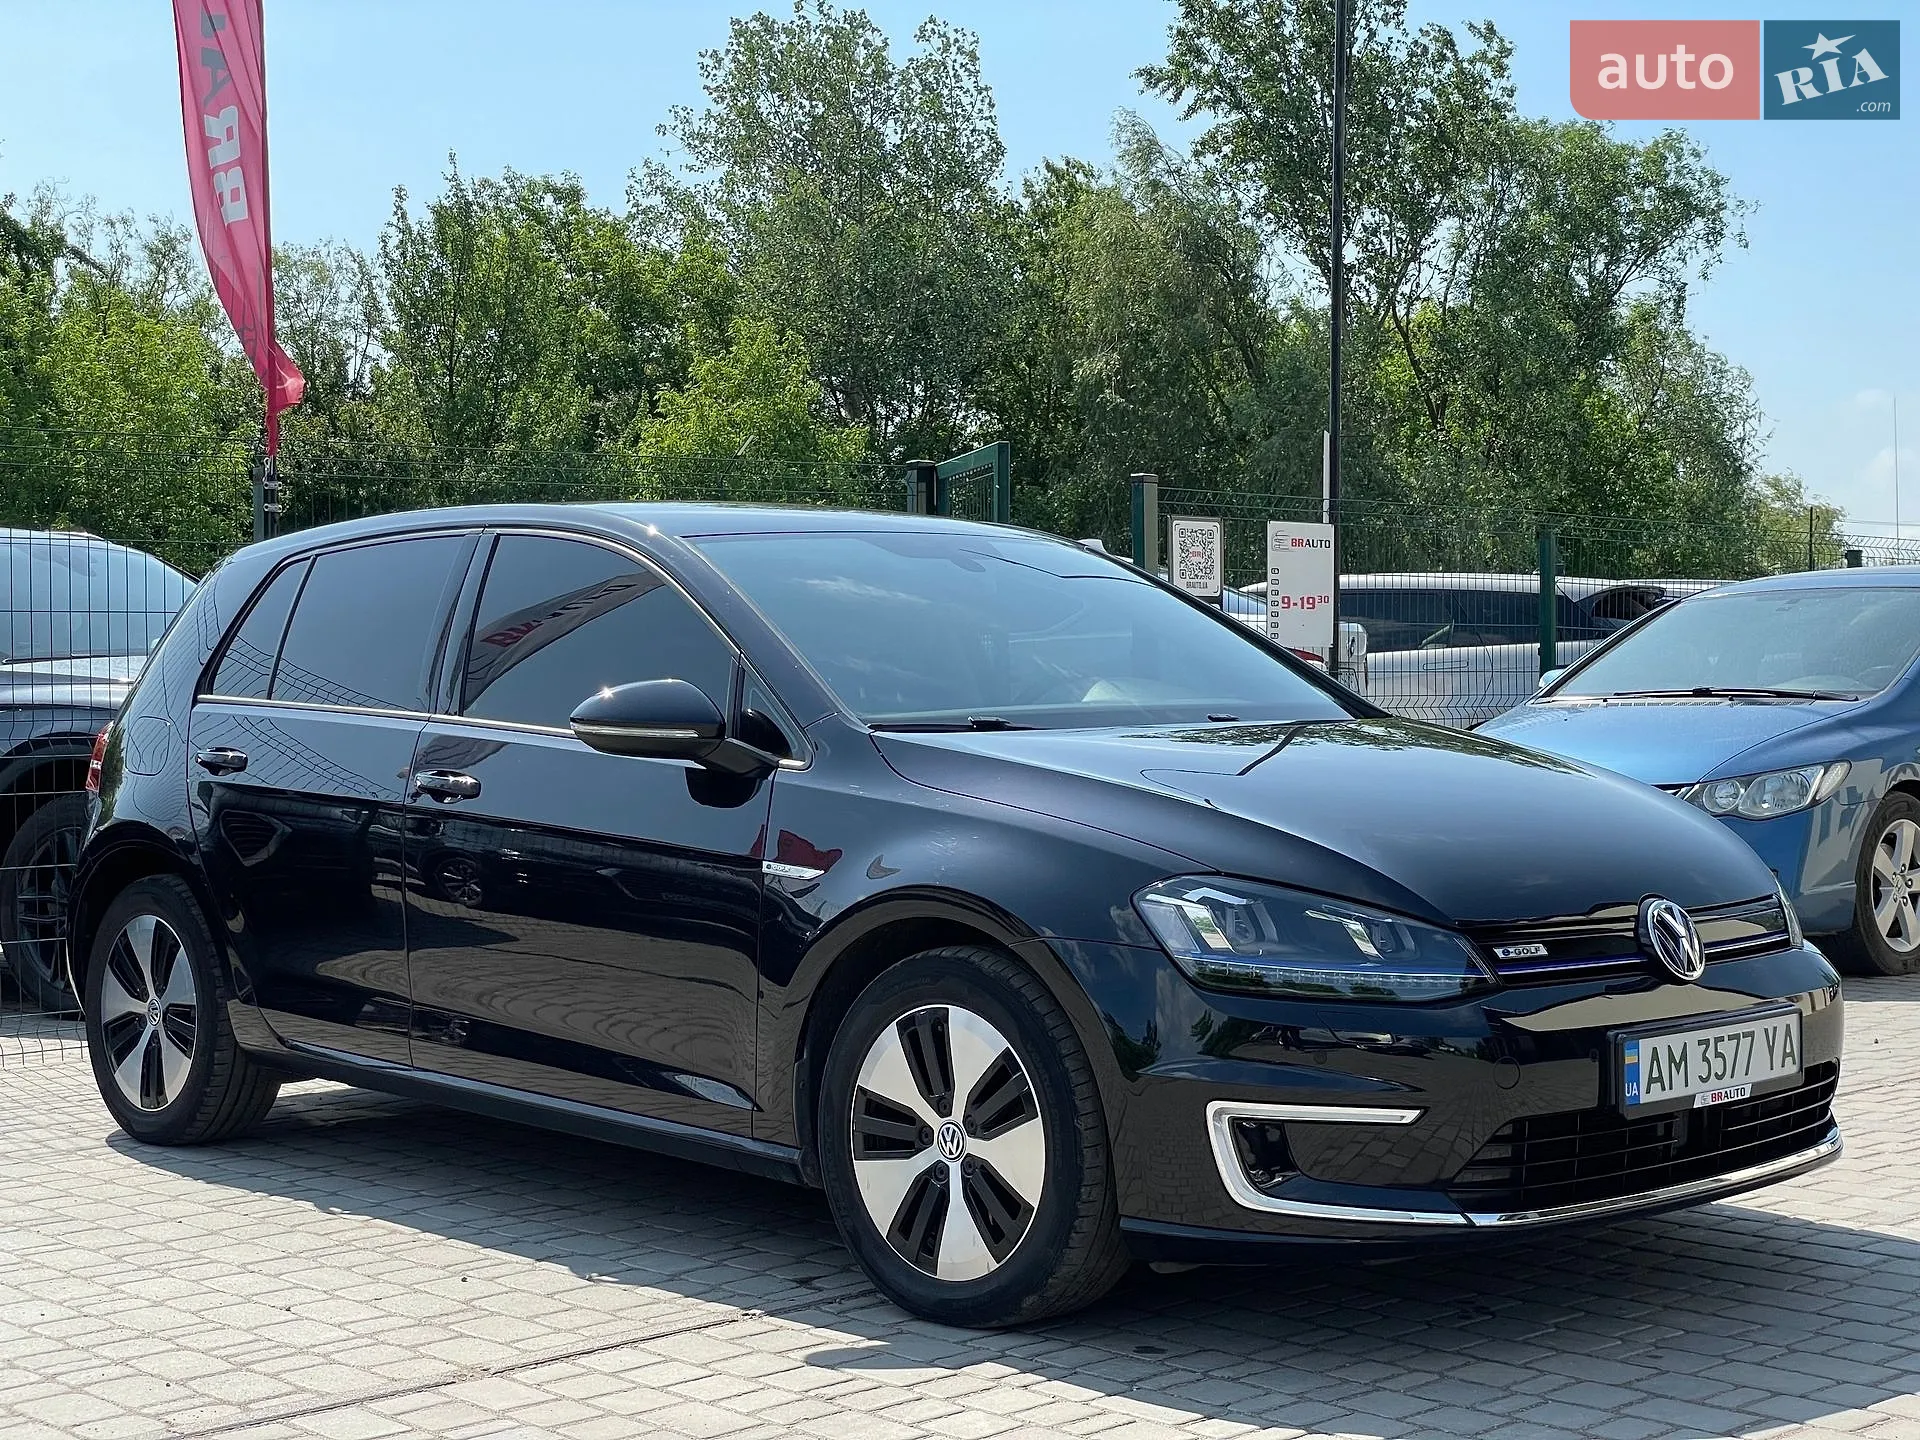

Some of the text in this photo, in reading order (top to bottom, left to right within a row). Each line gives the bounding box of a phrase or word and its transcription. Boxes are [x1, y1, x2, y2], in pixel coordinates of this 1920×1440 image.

[1290, 538, 1331, 549] BRAUTO
[1645, 1023, 1797, 1094] AM 3577 YA
[1625, 1082, 1639, 1098] UA
[1710, 1087, 1746, 1103] BRAUTO
